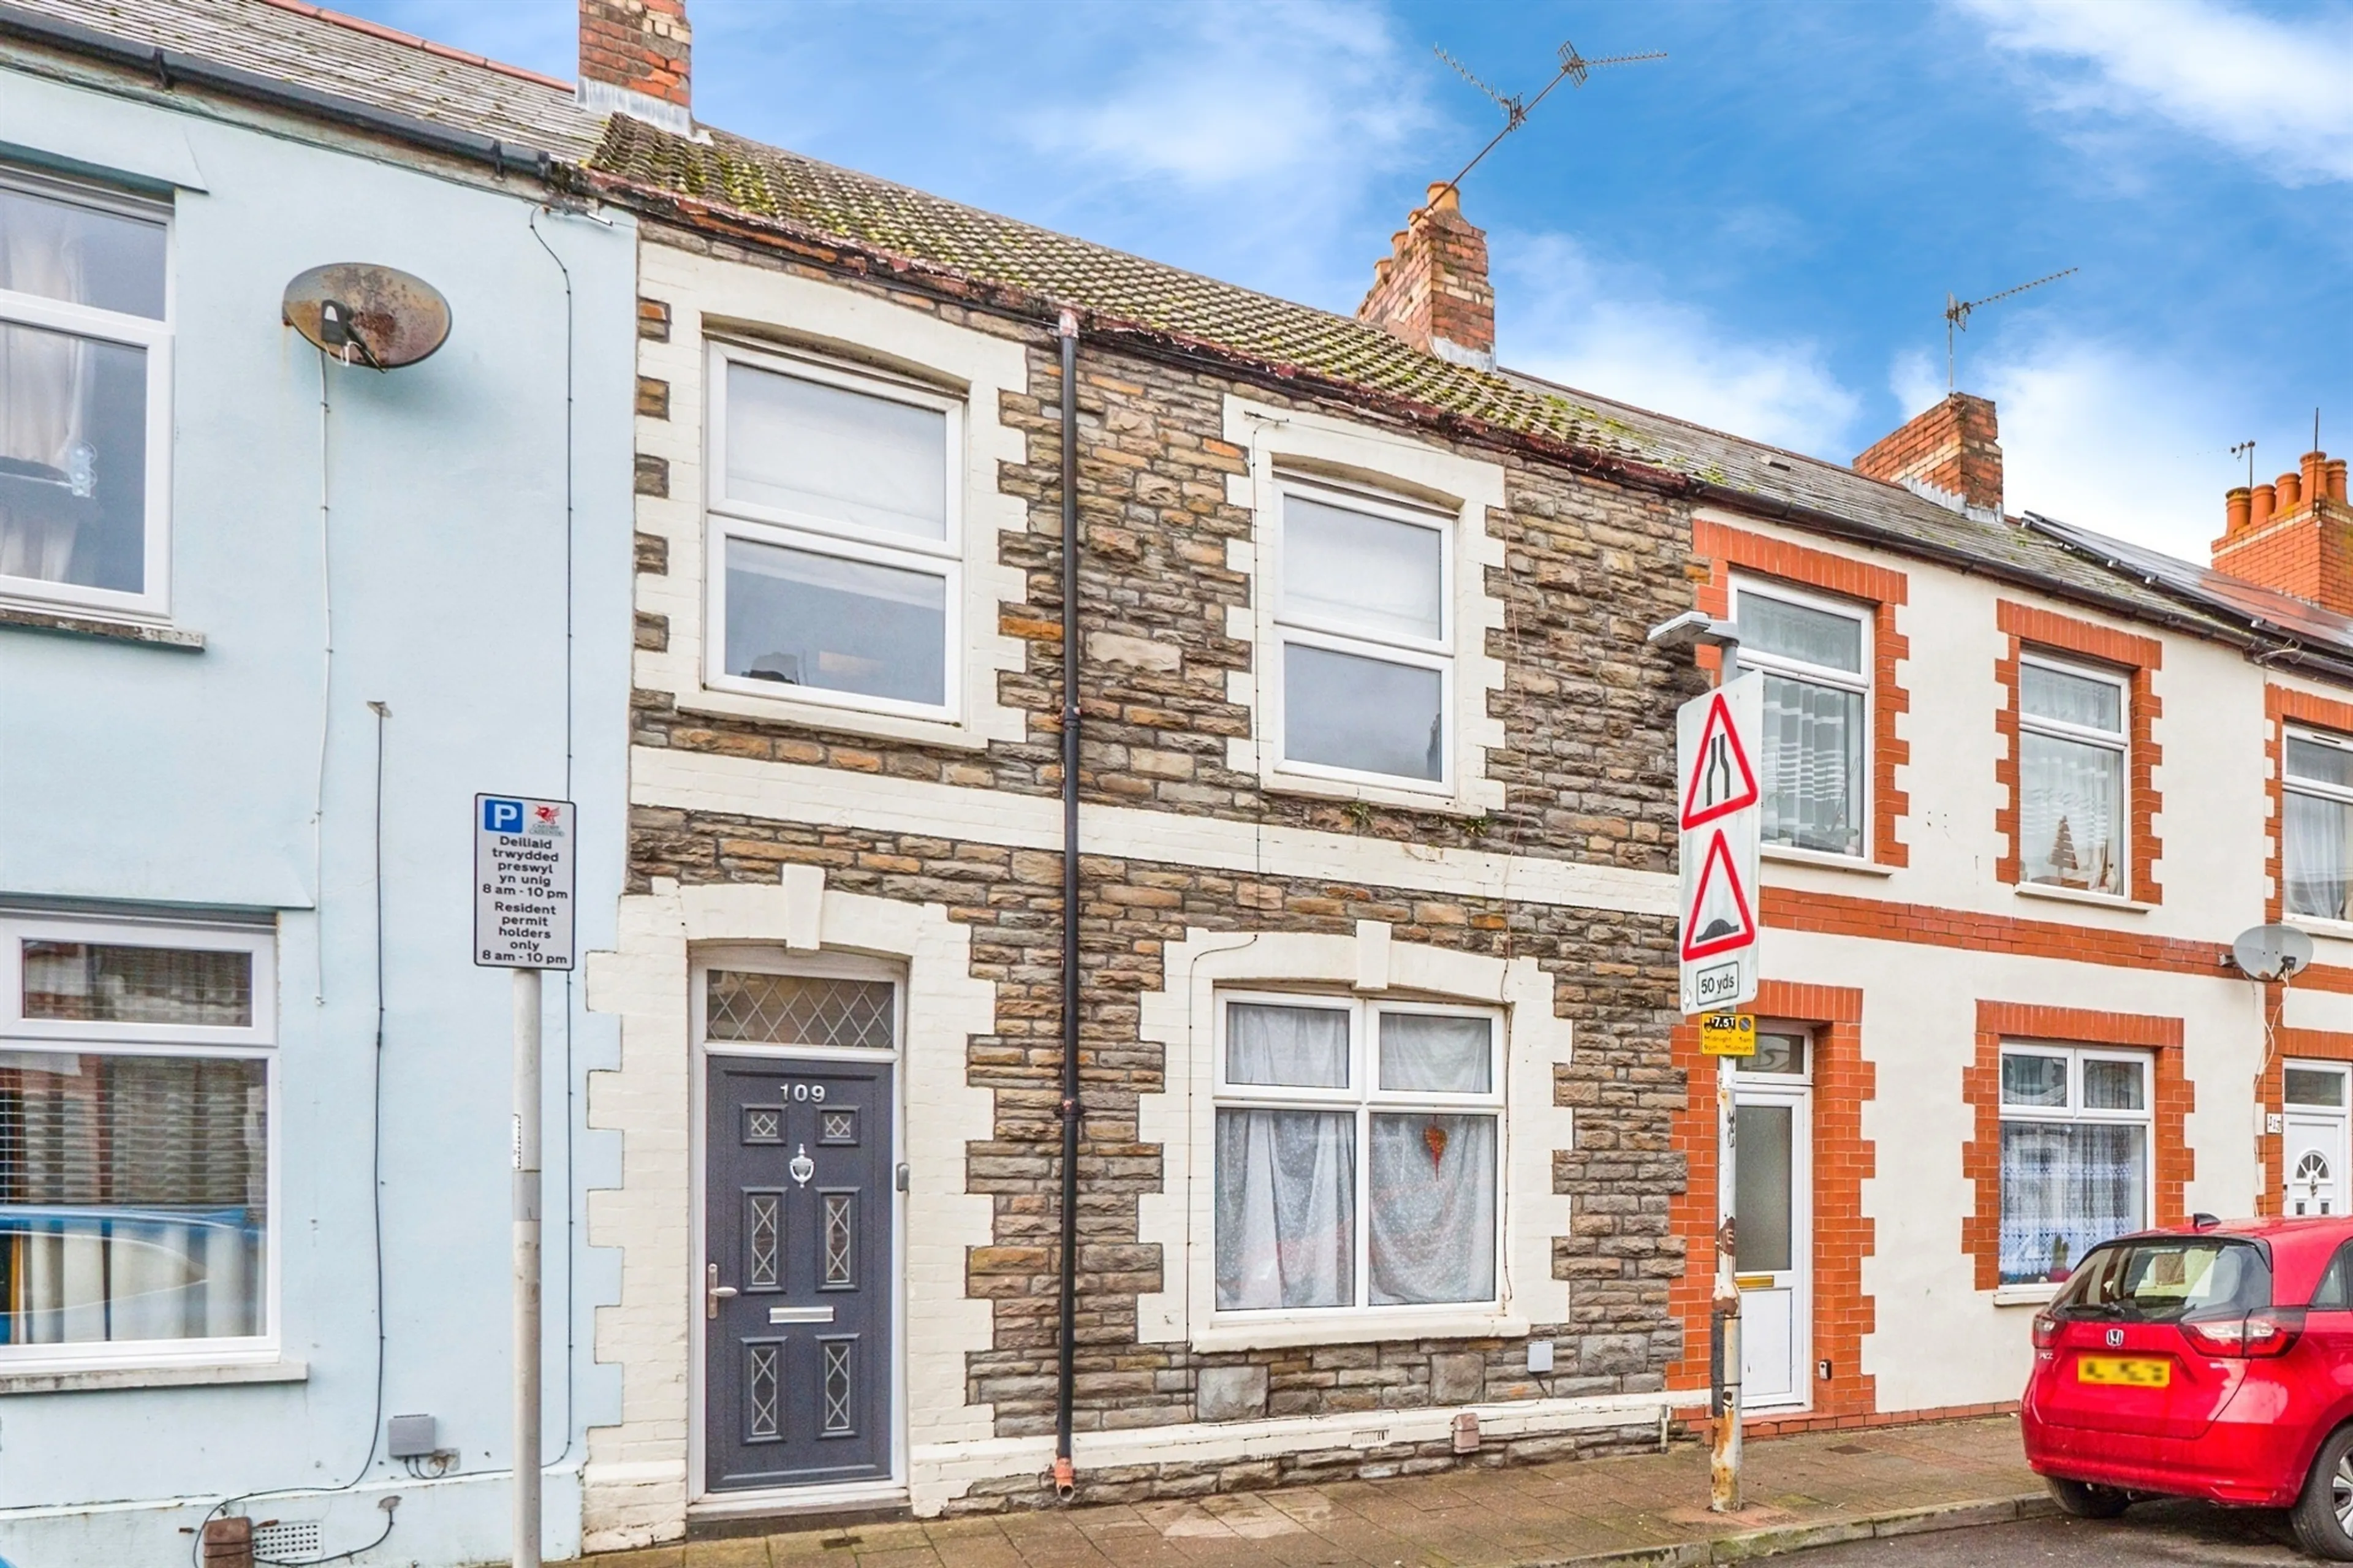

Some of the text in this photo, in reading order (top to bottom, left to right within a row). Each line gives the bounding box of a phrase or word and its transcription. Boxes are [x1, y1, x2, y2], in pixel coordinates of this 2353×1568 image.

[494, 803, 518, 829] P
[499, 836, 552, 849] Deiliaid
[492, 847, 559, 862] trwydded
[498, 862, 553, 874] preswyl
[499, 874, 551, 887] yn unig
[483, 884, 491, 893] 8
[495, 887, 515, 895] am
[527, 887, 543, 897] 10
[547, 890, 567, 899] pm
[494, 901, 556, 915] Resident
[502, 916, 548, 926] permit
[499, 926, 551, 939] holders
[510, 940, 540, 952] only
[482, 950, 491, 960] 8
[494, 952, 515, 961] am
[527, 953, 542, 963] 10
[547, 955, 567, 964] pm
[1701, 973, 1735, 994] 50 yds
[1714, 1017, 1735, 1028] 7.5T
[780, 1083, 825, 1103] 109
